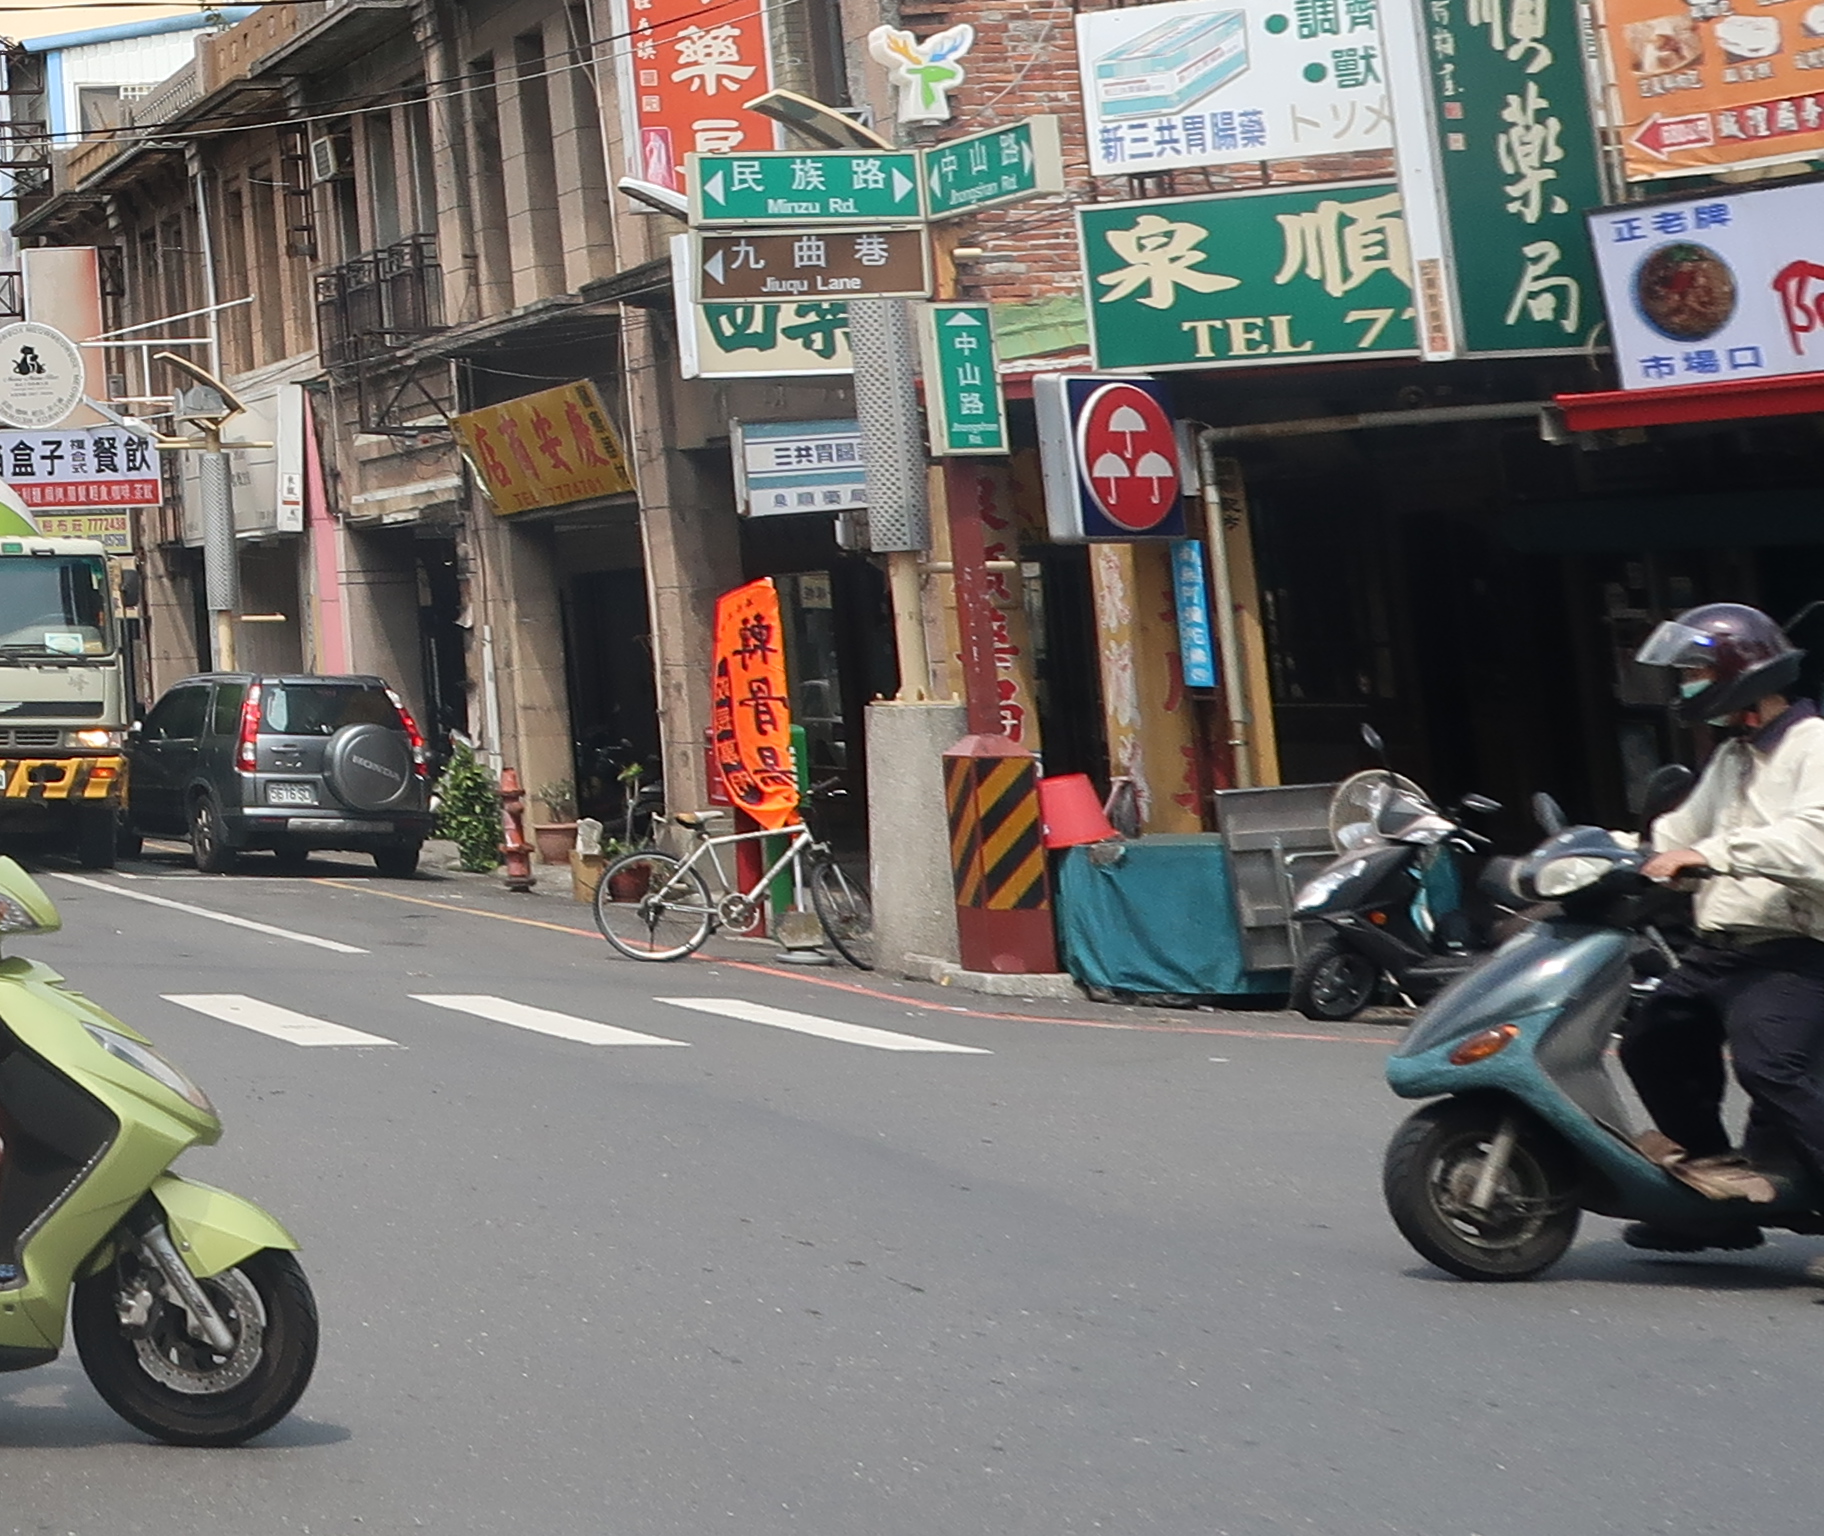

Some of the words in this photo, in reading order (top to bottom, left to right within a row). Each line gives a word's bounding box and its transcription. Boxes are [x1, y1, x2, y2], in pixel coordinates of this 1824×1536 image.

[1099, 109, 1266, 164] 新三共胃腸藥
[730, 159, 887, 192] 民族路
[941, 132, 1018, 183] 中山路
[767, 197, 821, 214] Minzu
[829, 196, 859, 213] Rd.
[1610, 203, 1733, 243] 正老牌
[730, 235, 889, 271] 九曲巷
[1097, 192, 1413, 309] 泉順
[761, 276, 811, 294] Jiuqu
[817, 275, 862, 293] Lane
[1182, 315, 1314, 357] TEL
[954, 332, 986, 416] 中山路
[1639, 346, 1764, 379] 市場口
[93, 435, 152, 474] 餐飲
